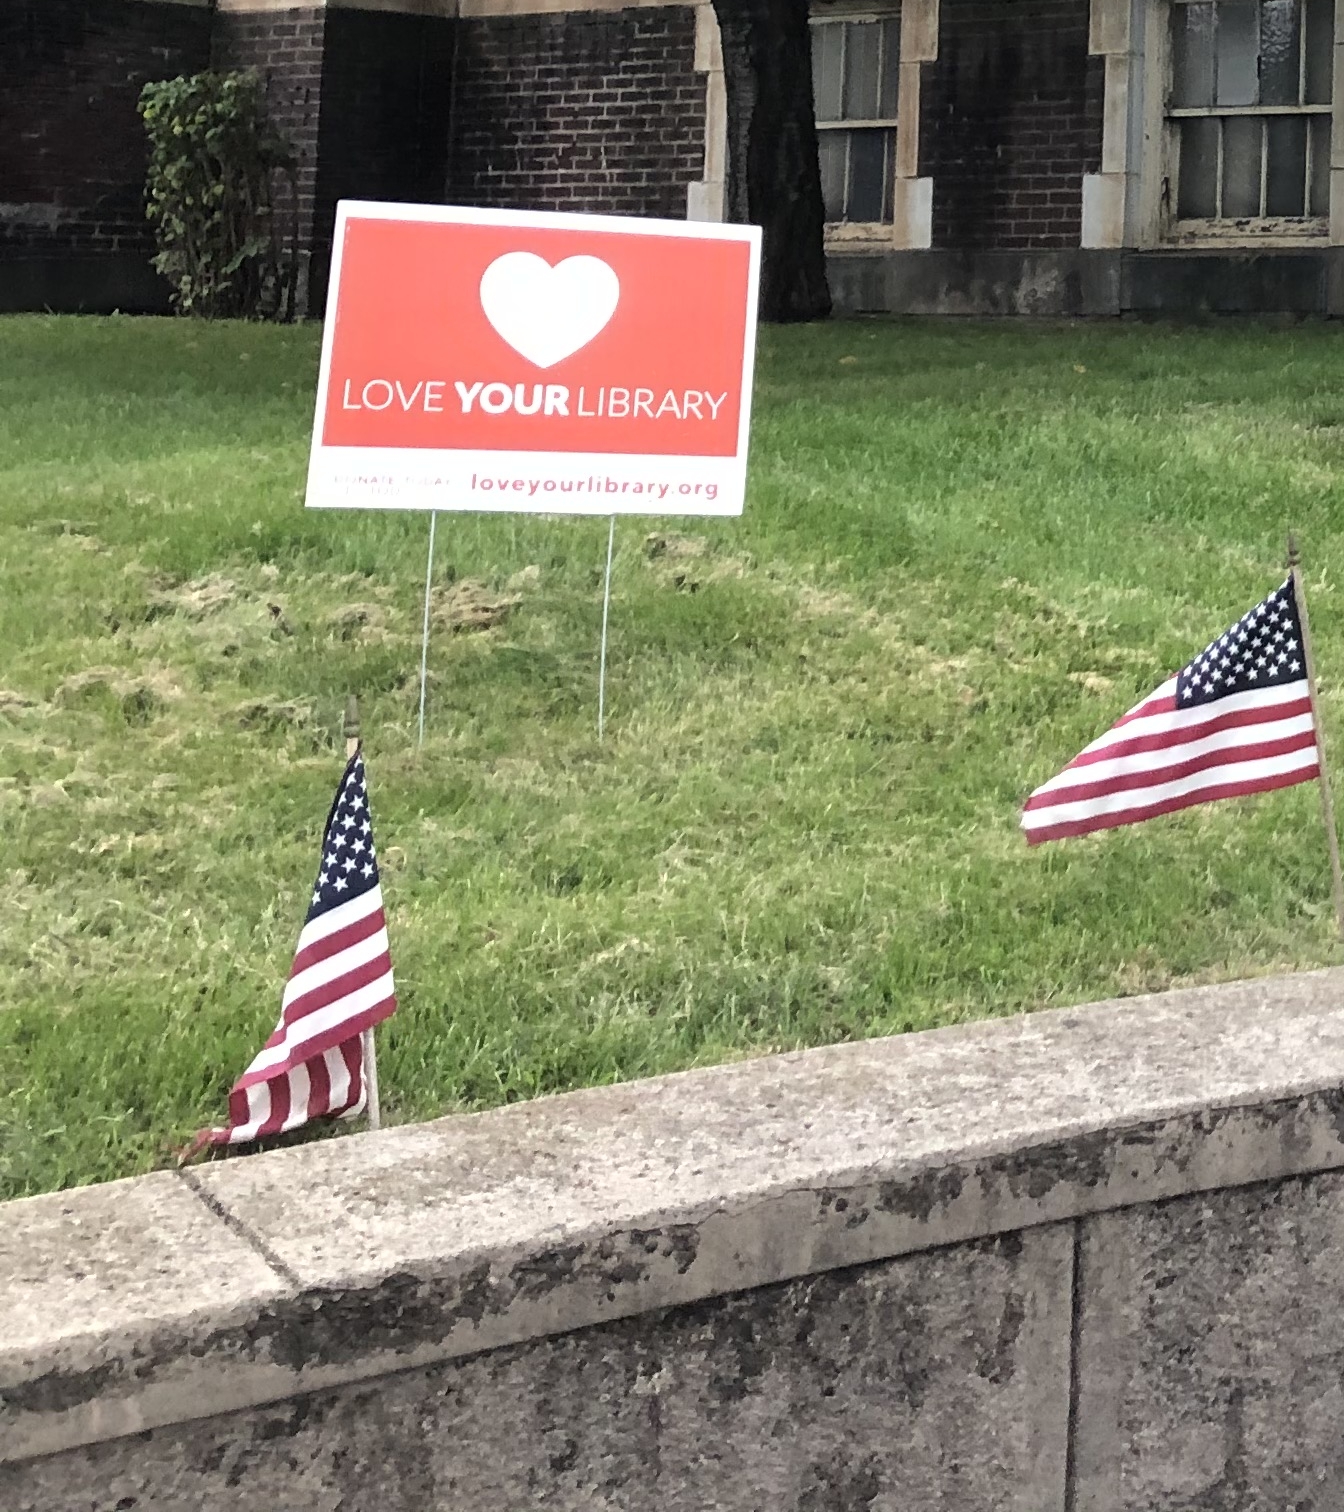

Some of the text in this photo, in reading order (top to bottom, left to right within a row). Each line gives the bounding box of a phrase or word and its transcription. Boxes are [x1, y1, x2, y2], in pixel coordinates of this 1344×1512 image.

[342, 378, 728, 421] LOVE YOUR LIBRARY
[471, 473, 719, 501] loveyourlibrary.org
